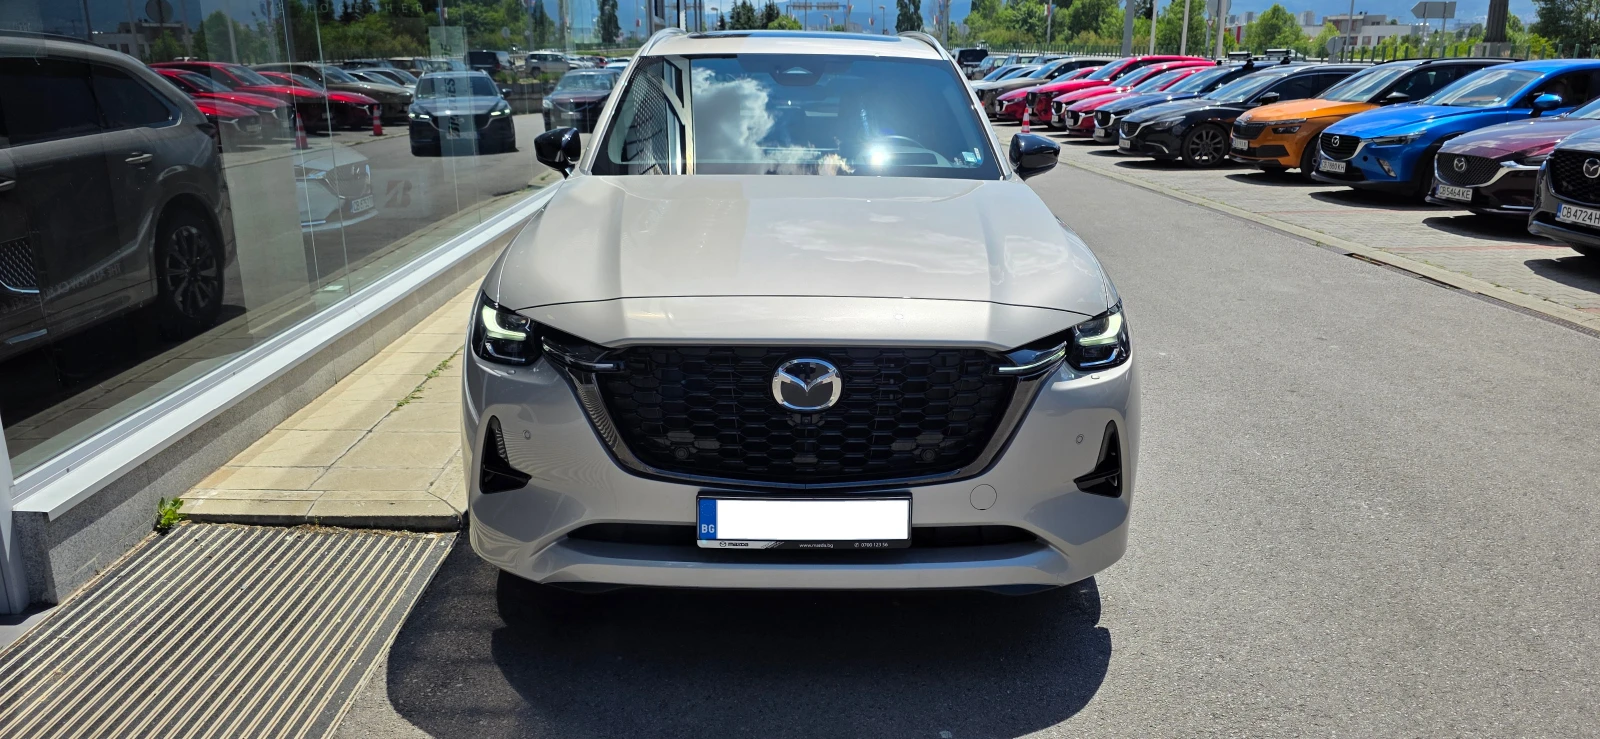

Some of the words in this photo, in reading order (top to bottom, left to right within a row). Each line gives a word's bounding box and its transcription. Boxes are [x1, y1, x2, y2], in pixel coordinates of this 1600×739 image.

[1461, 189, 1471, 199] KE
[1562, 206, 1572, 218] CB
[1572, 209, 1593, 223] 4724
[701, 524, 715, 534] BG
